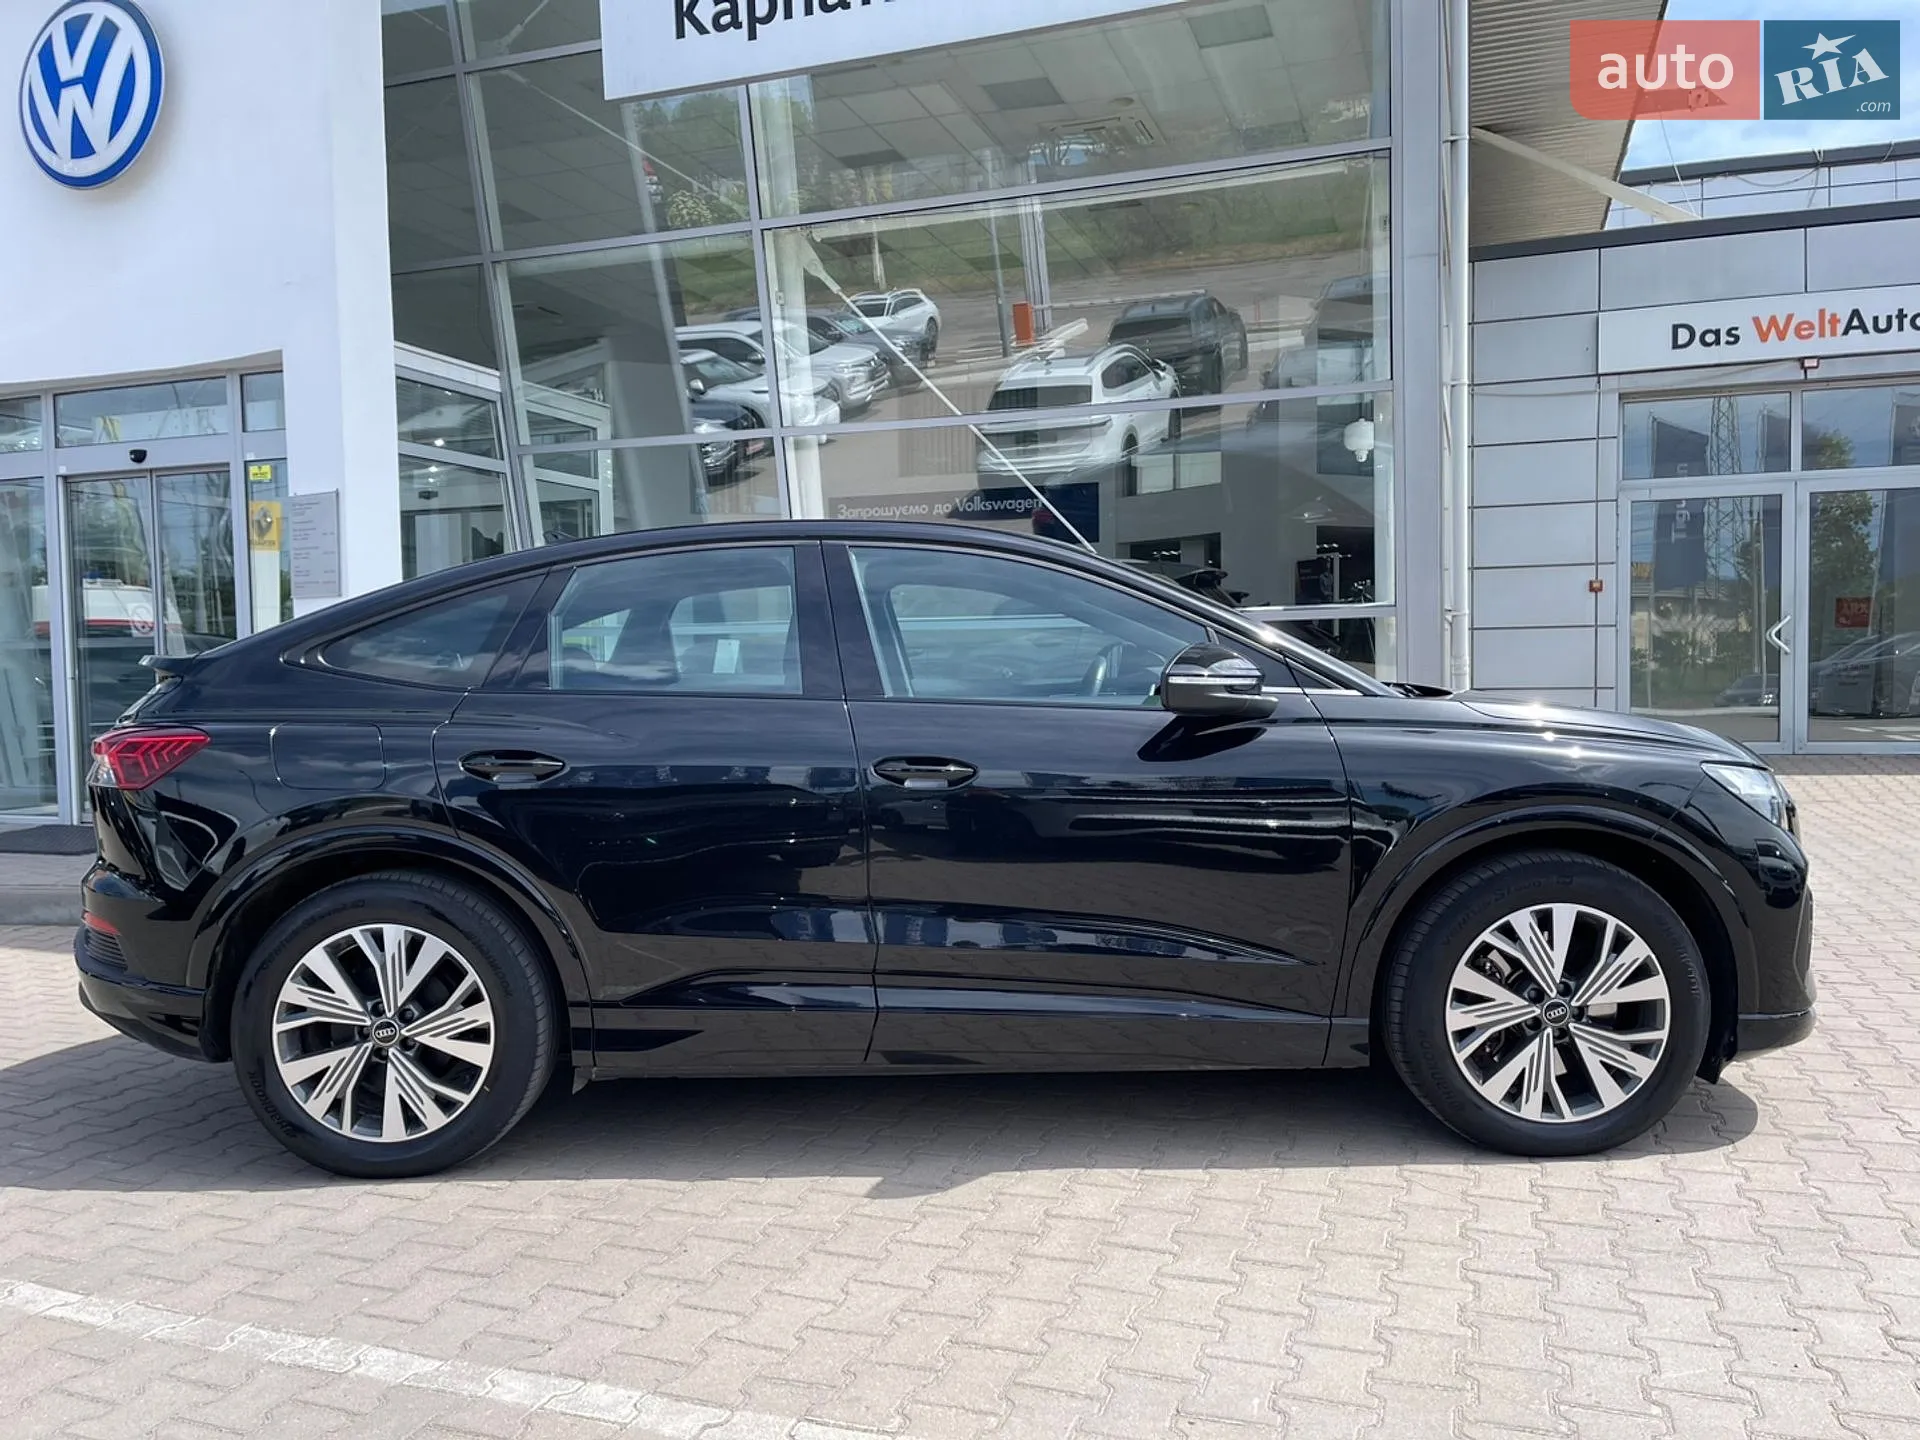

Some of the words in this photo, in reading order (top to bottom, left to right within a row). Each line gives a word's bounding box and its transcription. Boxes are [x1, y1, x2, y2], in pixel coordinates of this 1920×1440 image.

[1671, 323, 1740, 350] Das
[837, 503, 929, 520] Запрошуємо
[932, 502, 952, 516] до
[955, 495, 1044, 515] Volkswagen
